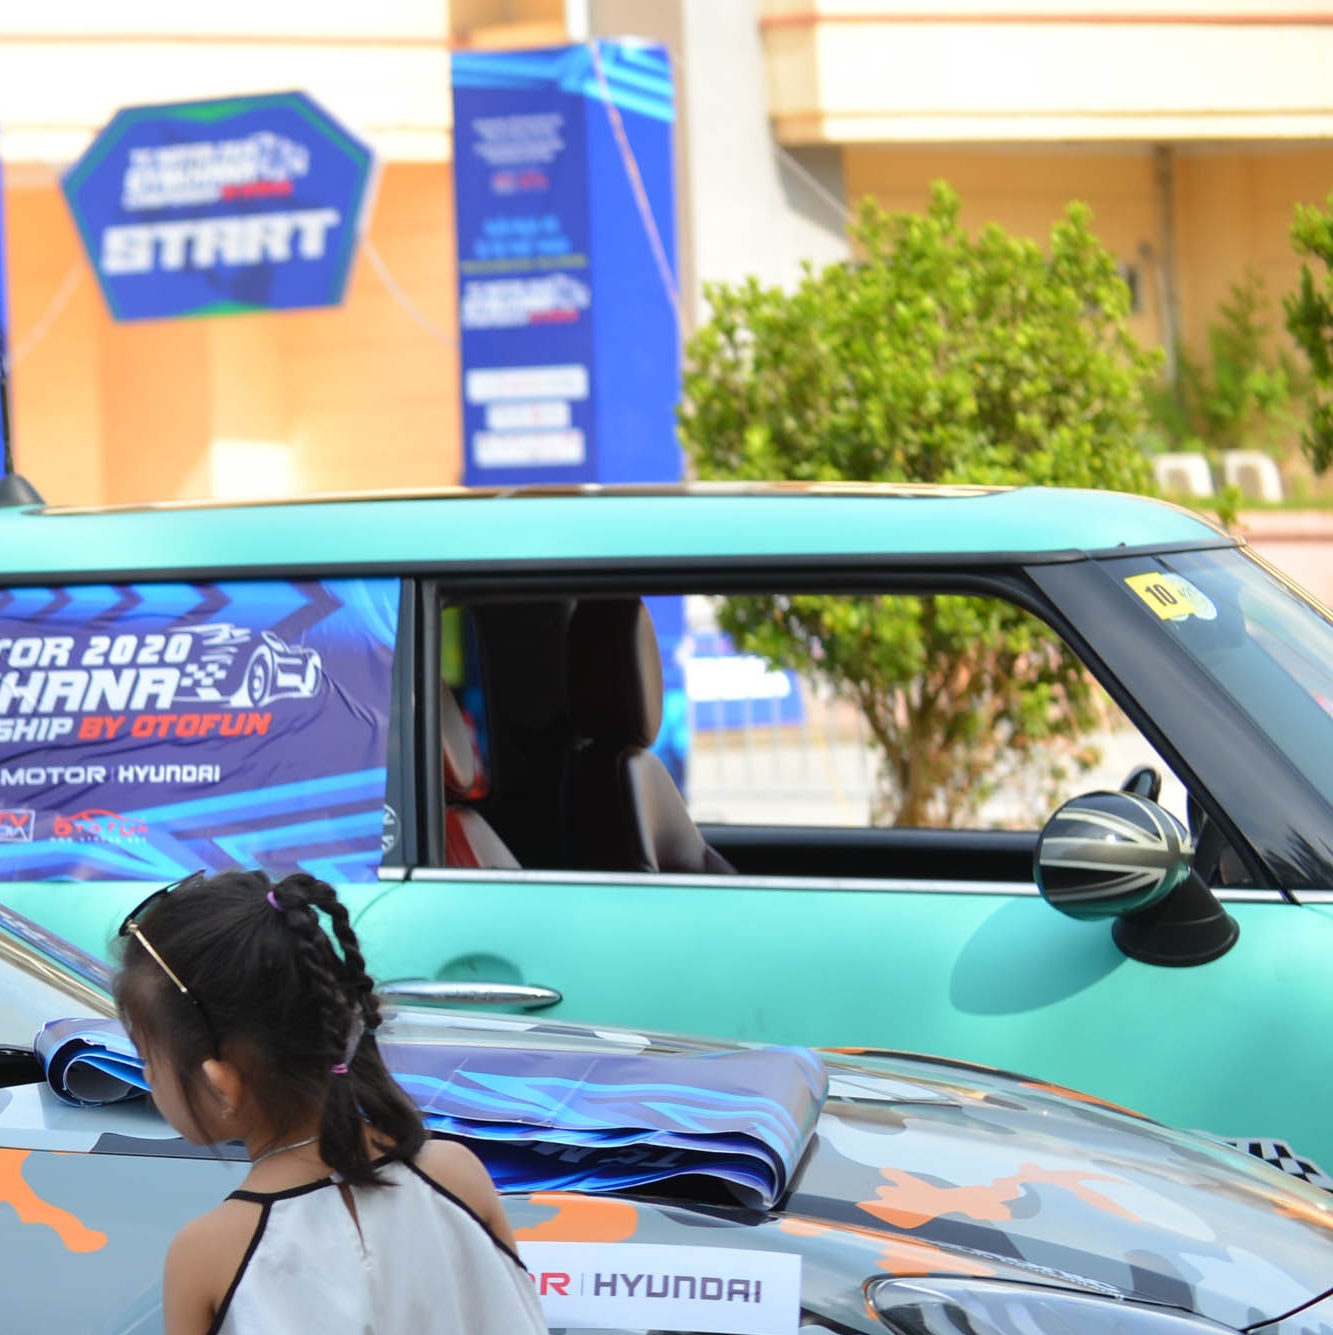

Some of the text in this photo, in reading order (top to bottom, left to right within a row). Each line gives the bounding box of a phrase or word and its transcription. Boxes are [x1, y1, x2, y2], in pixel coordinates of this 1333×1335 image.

[103, 208, 340, 275] START
[1145, 584, 1178, 607] 10
[81, 634, 193, 666] 2020
[78, 715, 125, 741] BY
[132, 713, 272, 739] OTOFUN
[0, 766, 106, 786] MOTOR
[119, 764, 221, 784] HYUNDAI
[594, 1273, 761, 1304] HYUNDAI
